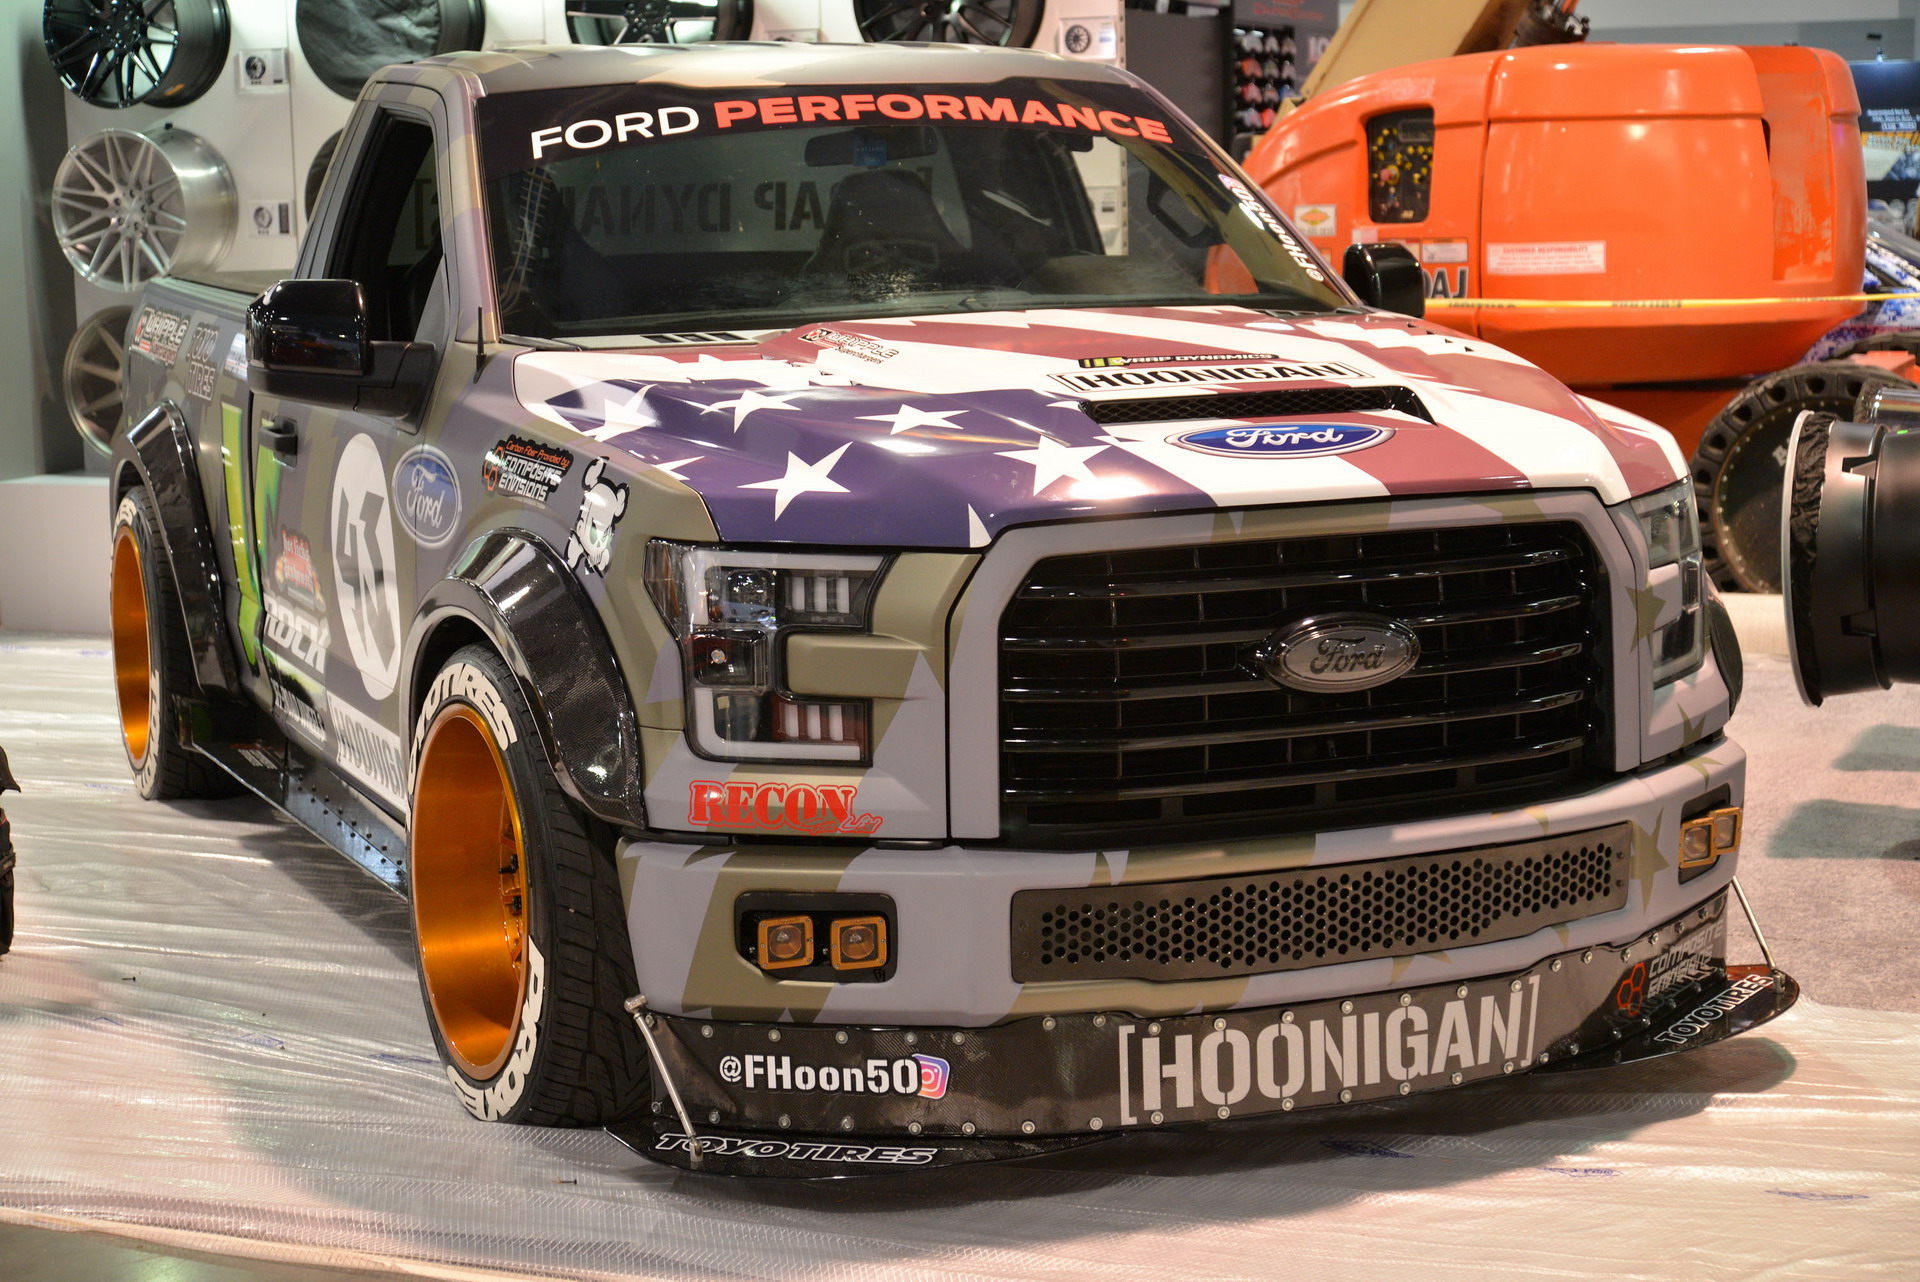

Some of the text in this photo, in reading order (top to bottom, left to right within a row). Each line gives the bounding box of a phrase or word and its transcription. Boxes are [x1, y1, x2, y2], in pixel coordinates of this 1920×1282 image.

[530, 94, 1173, 159] FORD PERFORMANCE
[824, 331, 899, 359] WHIPPLE
[1112, 353, 1274, 364] WRAP DYNAMICS
[188, 361, 215, 401] TIRES
[506, 440, 525, 454] Carbon
[524, 445, 539, 457] Fiber
[537, 449, 562, 464] Provided
[1225, 427, 1344, 449] Ford
[499, 473, 549, 502] ENVISIONS
[502, 455, 562, 486] COMPOSITE
[406, 463, 446, 529] Ford
[1310, 637, 1385, 675] Ford
[688, 780, 858, 831] RECON
[1648, 918, 1725, 979] COMPOSITE
[446, 935, 545, 1122] PROXES
[720, 1054, 919, 1094] @FHoon50
